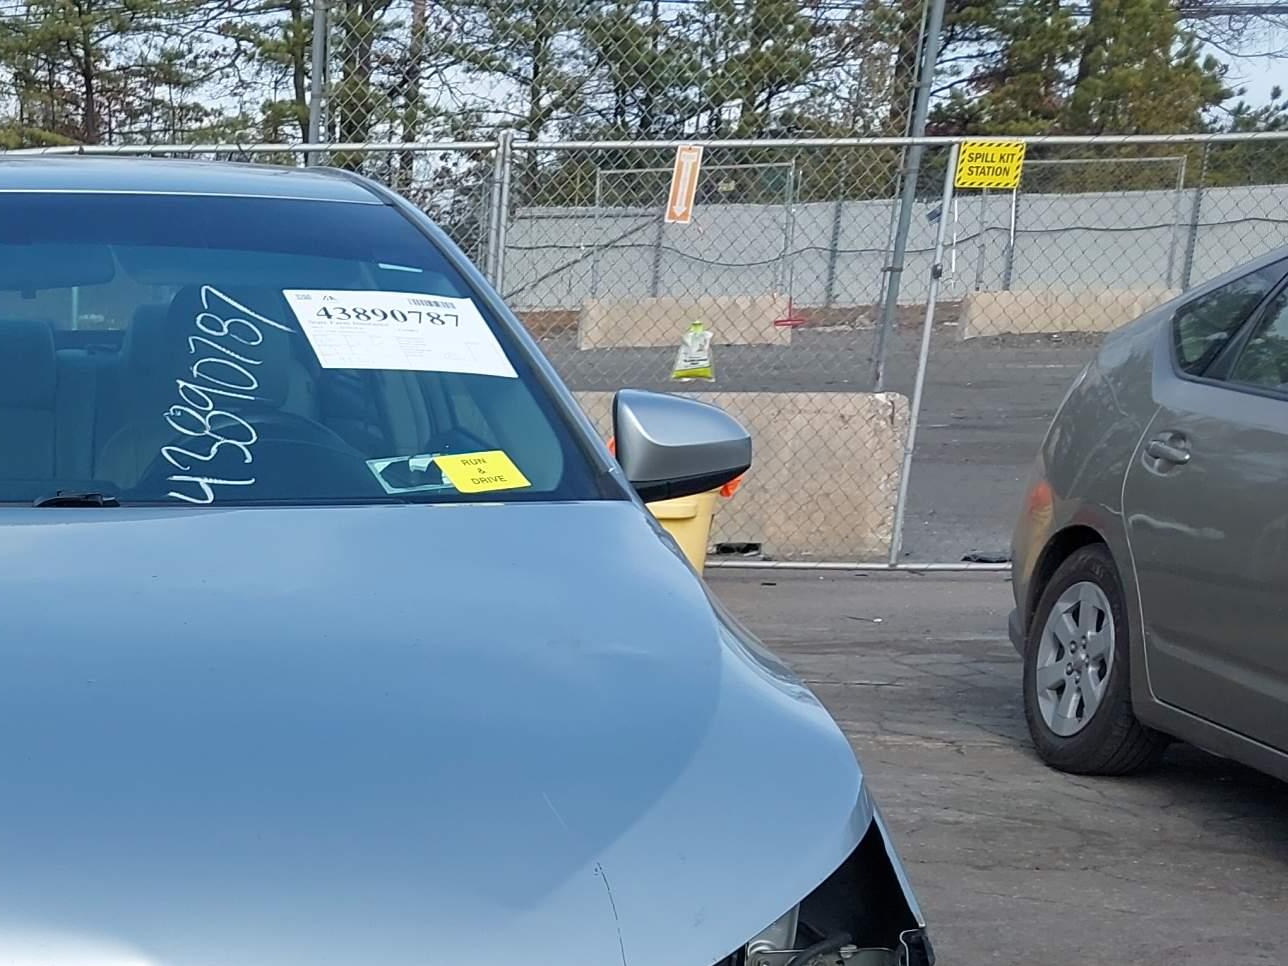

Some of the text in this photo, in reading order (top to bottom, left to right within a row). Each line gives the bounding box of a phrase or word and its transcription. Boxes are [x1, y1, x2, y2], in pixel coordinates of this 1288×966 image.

[967, 152, 1016, 164] SPILL KIT
[967, 165, 1010, 177] STATION
[315, 305, 460, 327] 43890787
[161, 285, 296, 505] 43890787
[460, 457, 488, 466] RUN
[471, 475, 508, 485] DRIVE
